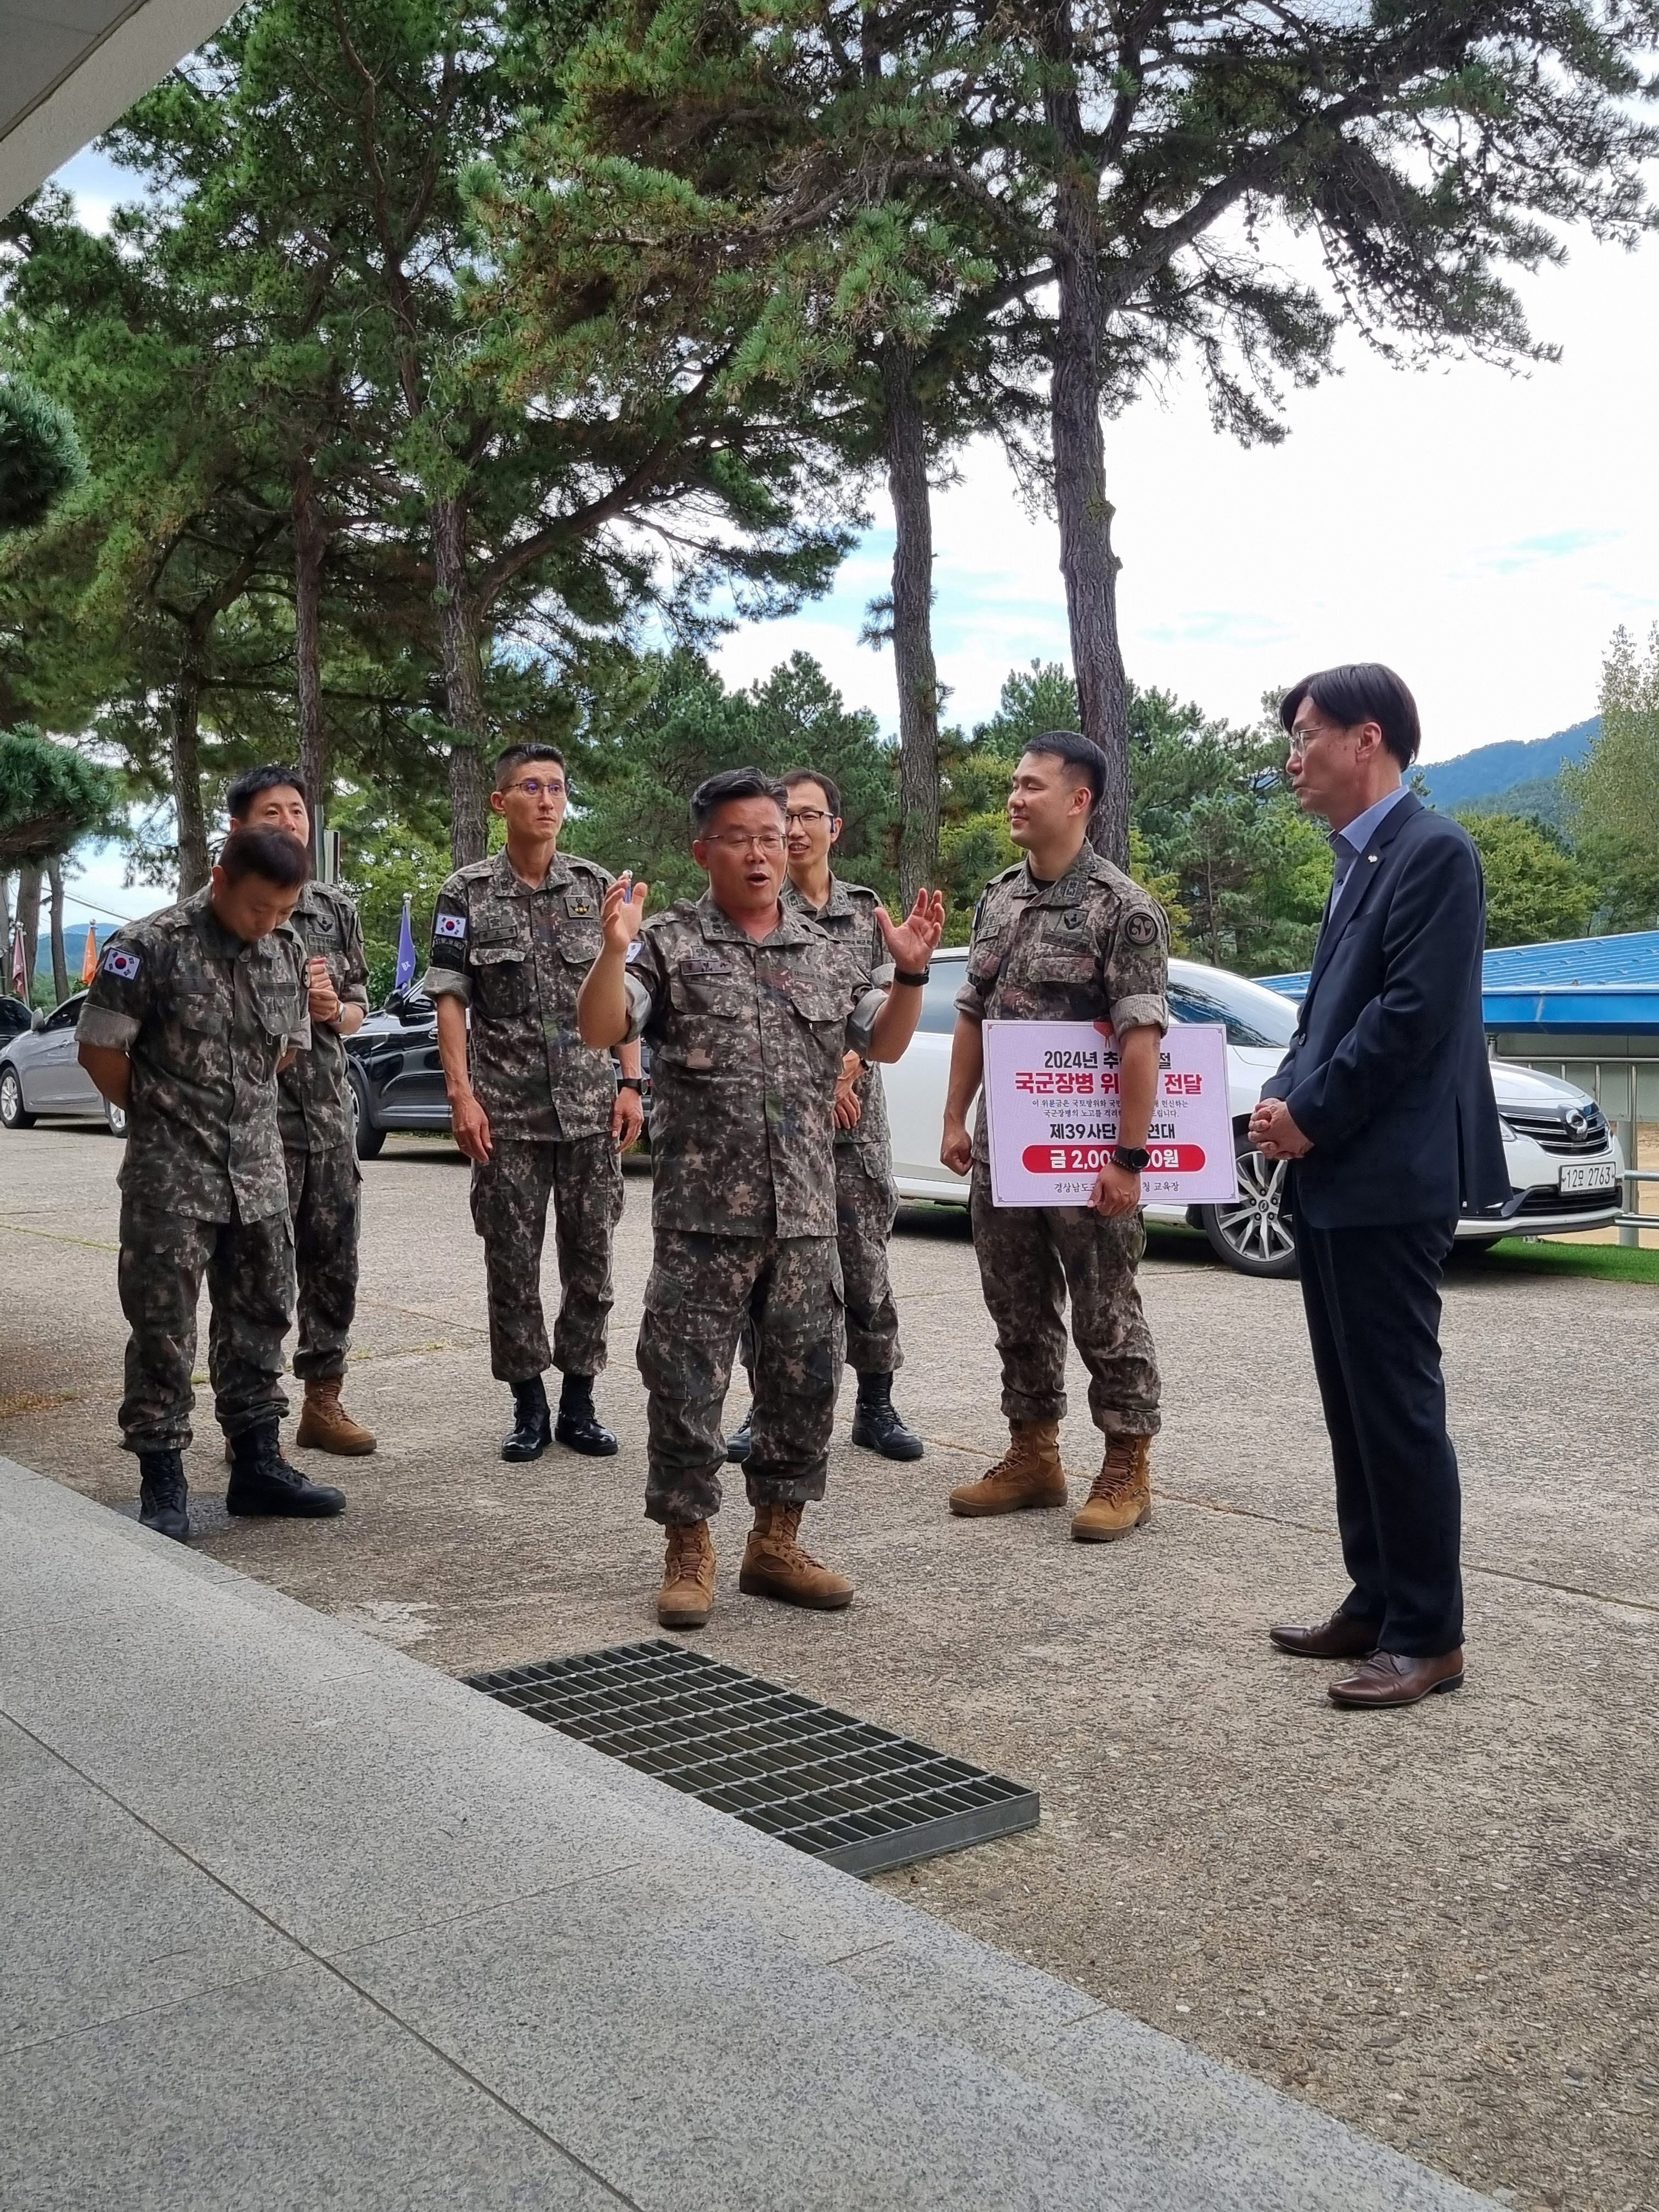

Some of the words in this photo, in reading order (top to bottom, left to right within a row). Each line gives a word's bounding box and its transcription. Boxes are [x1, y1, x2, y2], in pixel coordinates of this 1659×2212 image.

[1044, 1051, 1098, 1069] 2024년
[1103, 1051, 1122, 1069] 추
[1015, 1073, 1094, 1094] 국군장병
[1164, 1074, 1202, 1094] 전달
[1032, 1099, 1039, 1108] 이
[1042, 1099, 1070, 1108] 위문금은
[1073, 1099, 1106, 1108] 국토방위와
[1043, 1109, 1079, 1118] 국군장병의
[1081, 1109, 1102, 1118] 노고를
[1050, 1124, 1116, 1139] 제39사단
[1050, 1150, 1066, 1168] 금
[1567, 1169, 1584, 1188] 12모
[1588, 1166, 1611, 1186] 2763
[1154, 1181, 1180, 1192] 교육장
